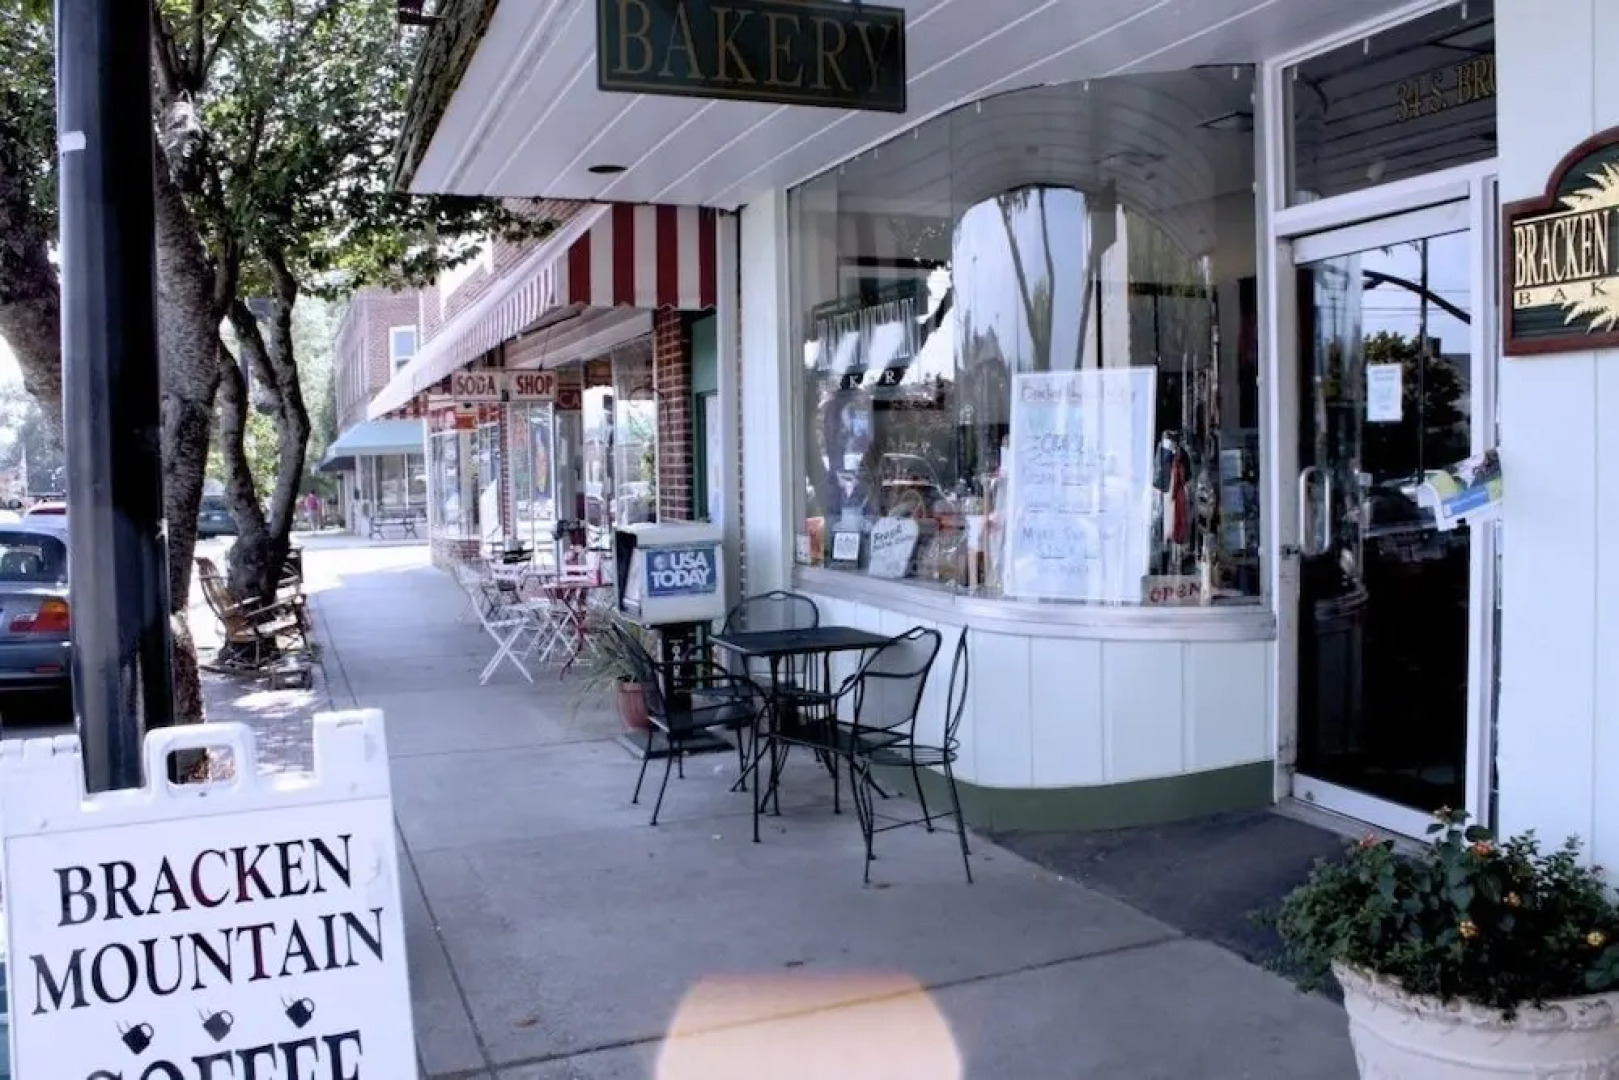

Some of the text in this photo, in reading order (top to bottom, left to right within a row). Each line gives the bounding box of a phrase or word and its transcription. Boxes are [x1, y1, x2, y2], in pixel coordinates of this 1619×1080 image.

[611, 0, 895, 93] BAKERY
[1513, 209, 1610, 288] BRACKEN
[456, 374, 554, 396] SODA SHOP
[651, 566, 712, 589] TODAY
[670, 550, 708, 570] USA
[53, 833, 353, 927] BRACKEN
[29, 906, 385, 1016] MOUNTAIN
